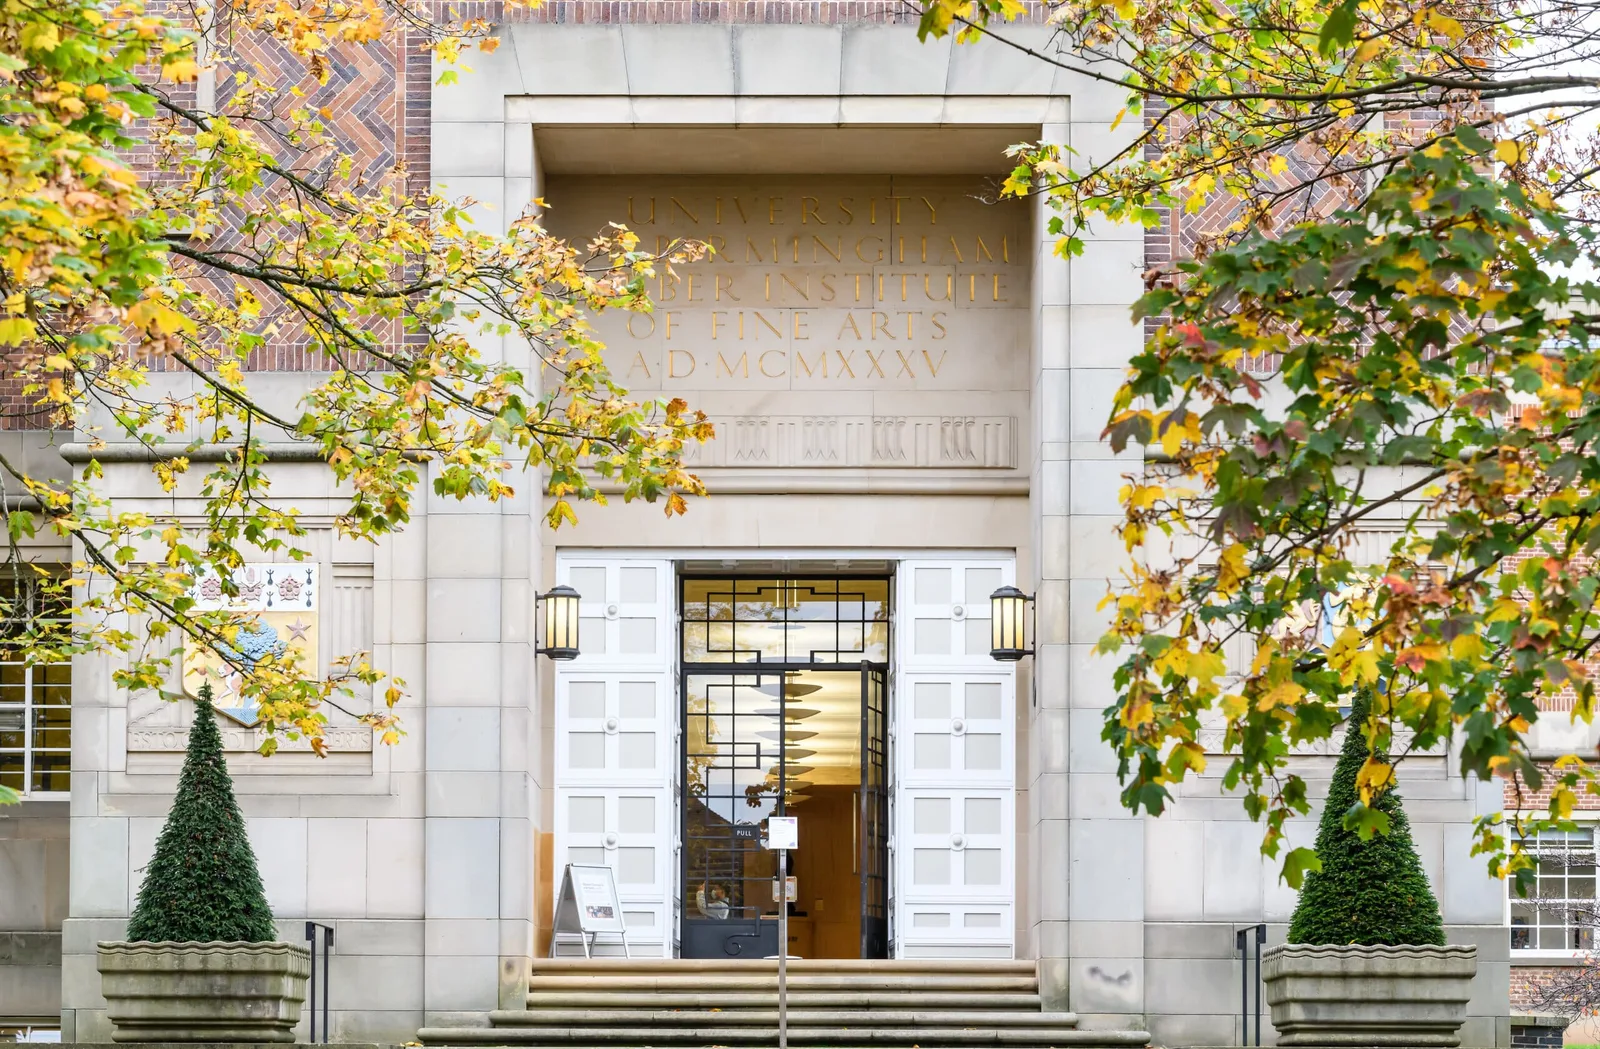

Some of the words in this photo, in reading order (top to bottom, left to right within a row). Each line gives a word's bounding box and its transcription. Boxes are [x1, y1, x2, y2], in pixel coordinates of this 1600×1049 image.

[627, 196, 939, 225] UNIVERSITY
[764, 272, 1009, 301] INSTITUTE
[626, 311, 682, 340] OF
[711, 311, 811, 340] FINE
[837, 311, 948, 340] ARTS
[736, 829, 752, 837] PULL
